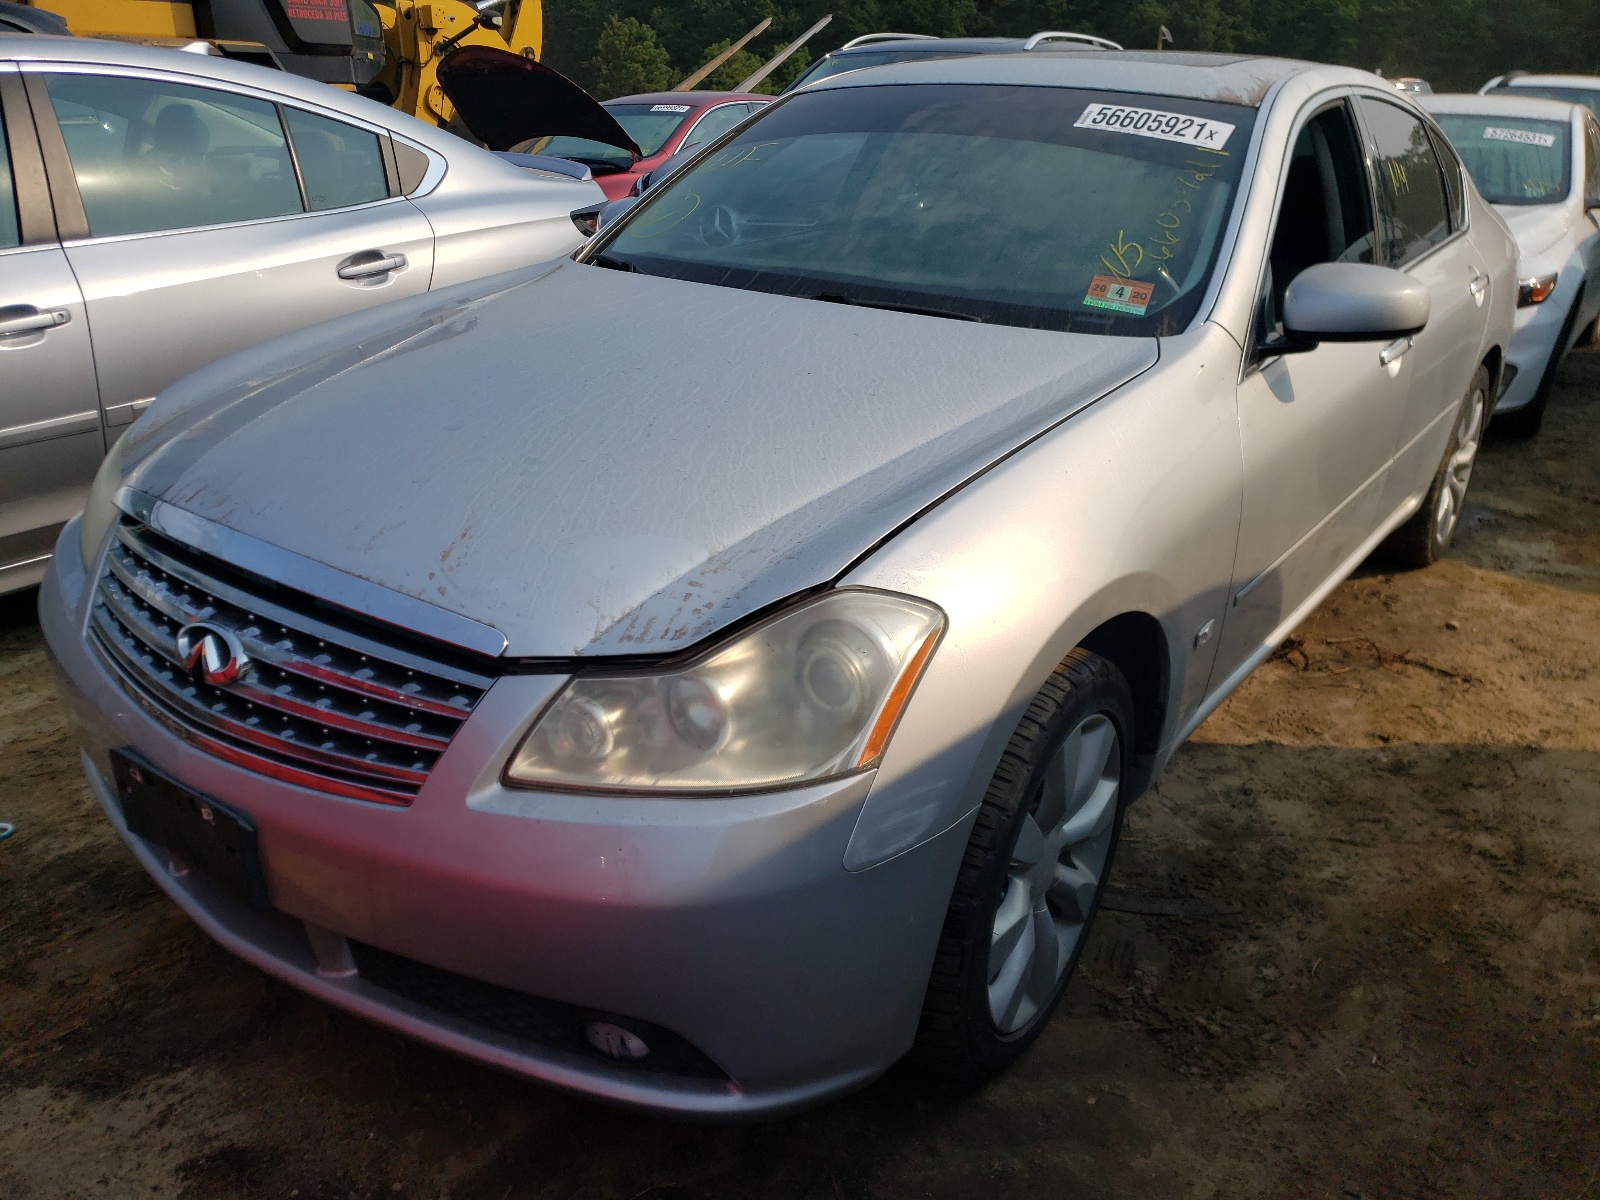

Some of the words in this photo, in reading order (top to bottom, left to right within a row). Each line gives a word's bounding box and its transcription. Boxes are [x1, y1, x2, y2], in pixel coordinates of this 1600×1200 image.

[1092, 283, 1107, 293] 20
[1115, 286, 1125, 298] 4
[1132, 291, 1148, 301] 20
